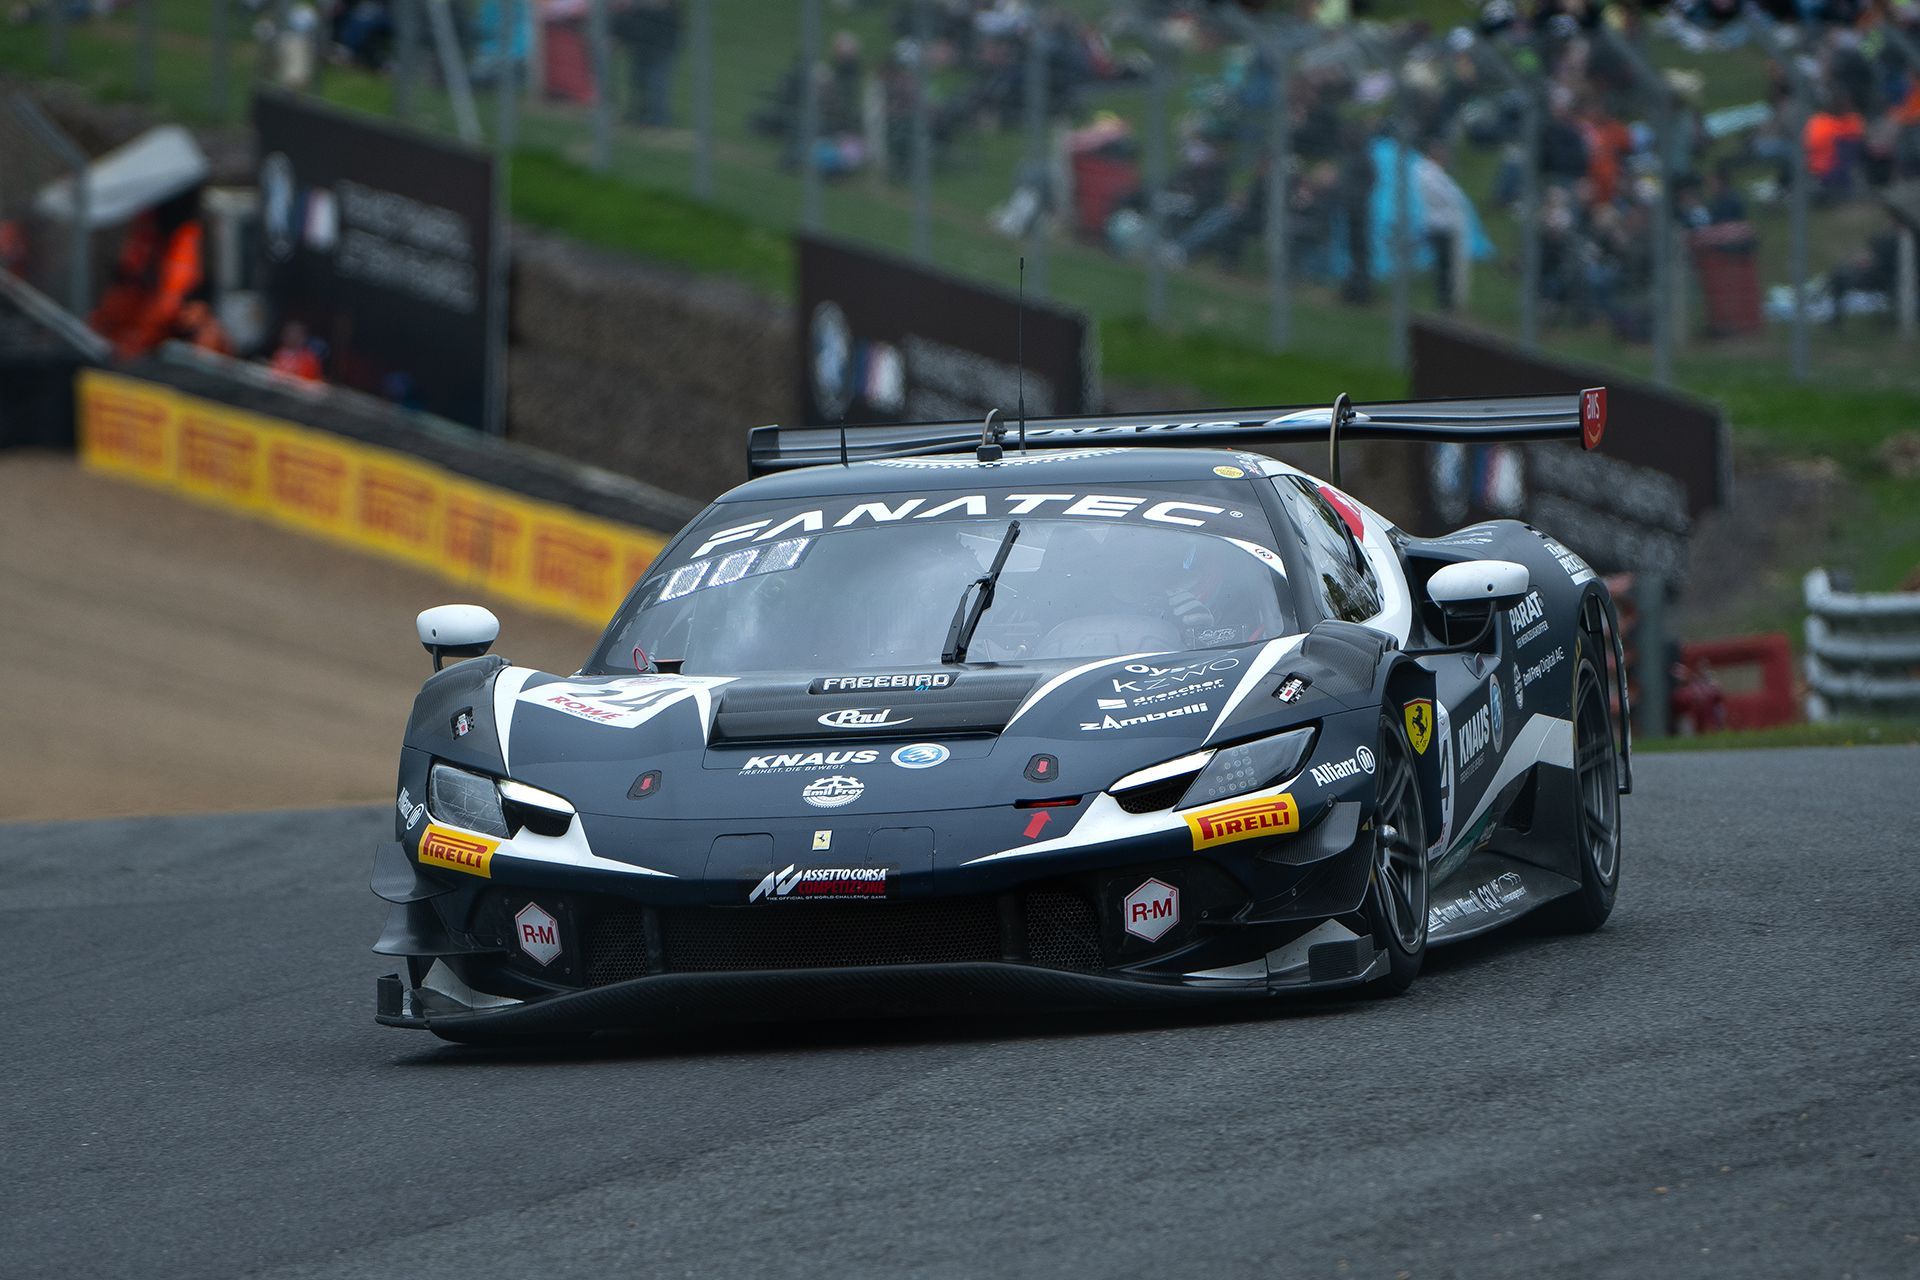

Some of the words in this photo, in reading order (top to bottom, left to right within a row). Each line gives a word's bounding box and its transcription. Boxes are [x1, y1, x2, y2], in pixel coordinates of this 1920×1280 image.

[689, 494, 1226, 560] FANATEC
[1509, 591, 1543, 635] PARAT
[823, 674, 950, 691] FREEBIRD
[1132, 678, 1224, 703] drescher
[547, 696, 624, 721] ROWE
[834, 708, 892, 726] Paul
[1458, 703, 1490, 769] KNAUS
[738, 767, 784, 776] FREIHEIT.
[742, 750, 880, 769] KNAUS
[1309, 757, 1361, 788] Allianz
[802, 787, 832, 797] Emil
[834, 787, 865, 797] Frey
[1196, 801, 1290, 841] PIRELLI
[423, 831, 489, 869] PIRELLI
[803, 869, 850, 882] ASSETTO
[850, 868, 887, 882] CORSA
[1131, 897, 1173, 923] R-M
[522, 924, 556, 945] R-M
